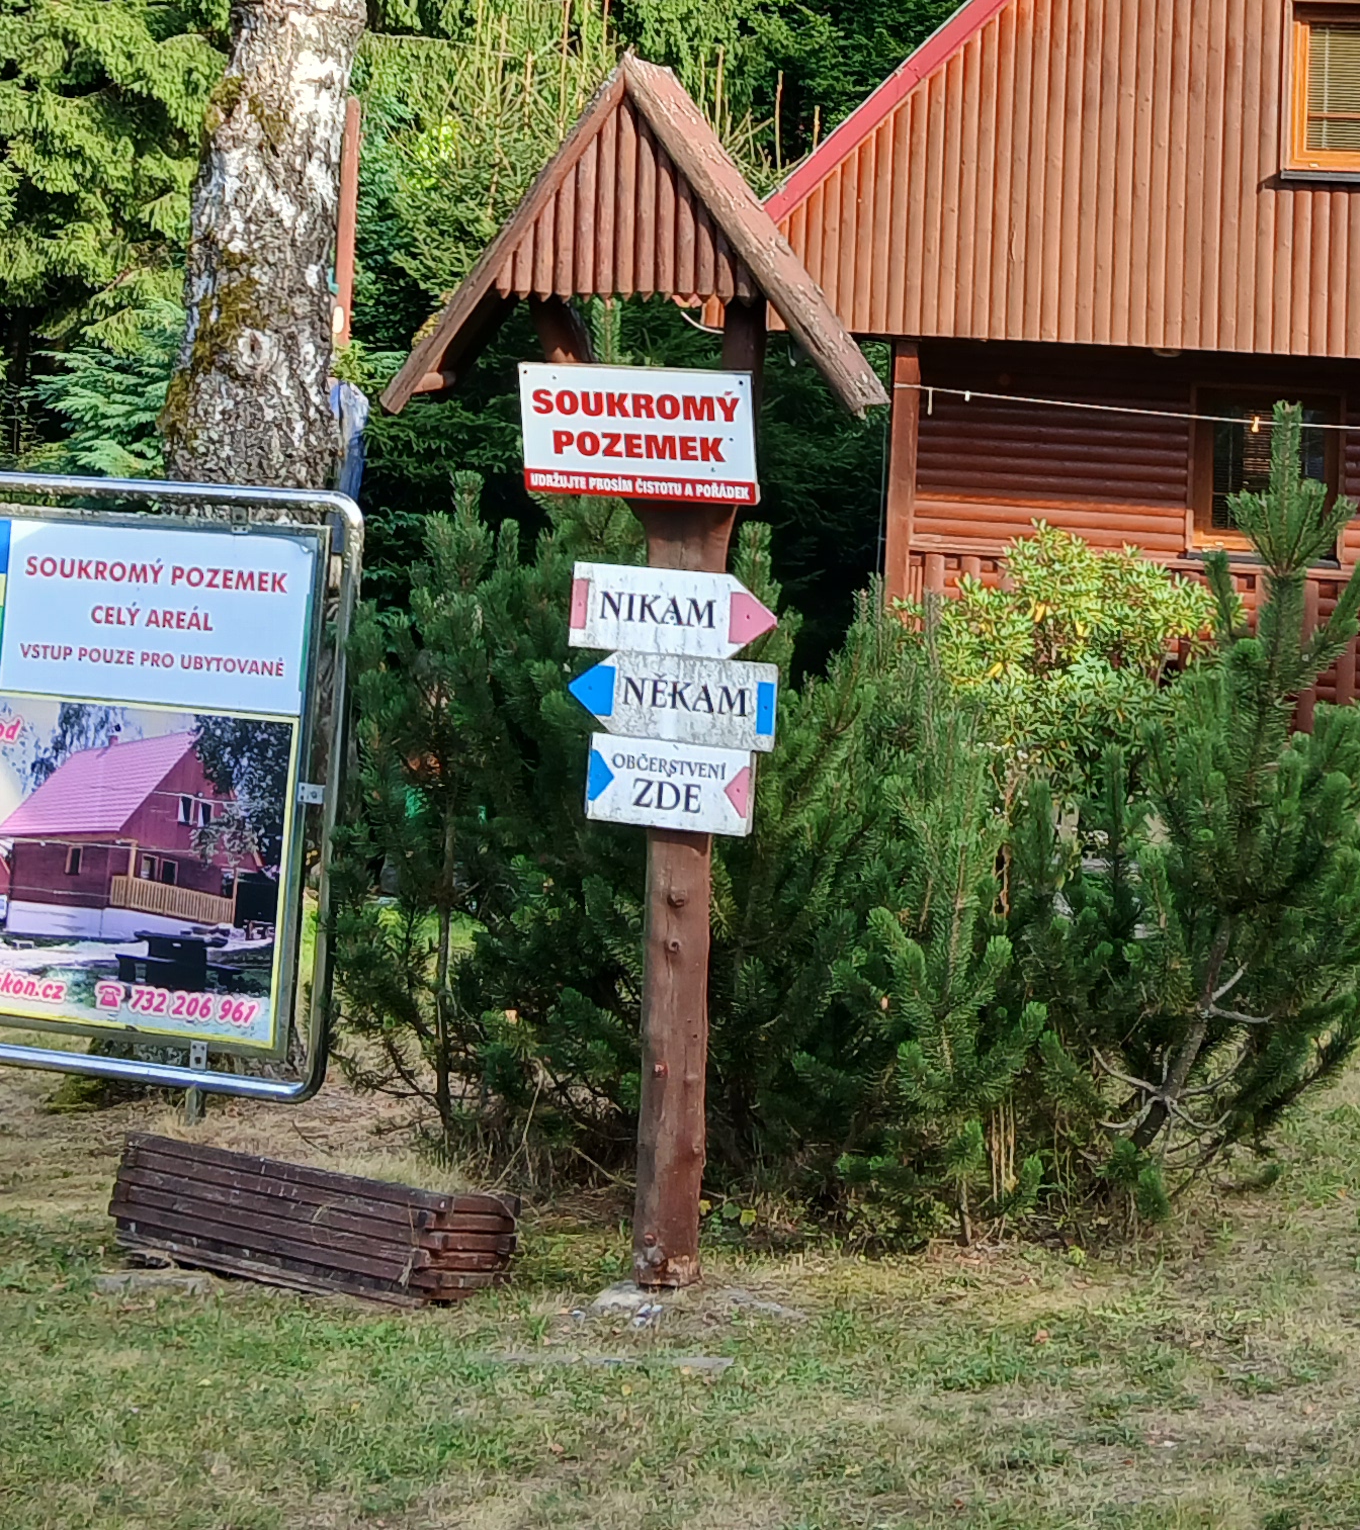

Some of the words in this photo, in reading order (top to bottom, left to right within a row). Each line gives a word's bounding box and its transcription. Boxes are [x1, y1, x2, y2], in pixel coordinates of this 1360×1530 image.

[531, 388, 740, 423] SOUKROMÝ
[552, 429, 726, 463] POZEMEK
[530, 471, 587, 490] UDRŽUJTE
[588, 476, 633, 492] PROSÍM
[635, 477, 682, 496] ČISTOTU
[684, 483, 693, 496] A
[696, 481, 750, 500] POŘÁDEK
[24, 555, 165, 585] SOUKROMÝ
[170, 565, 288, 594] POZEMEK
[90, 601, 140, 626] CELÝ
[145, 605, 213, 631] AREÁL
[599, 590, 716, 629] NIKAM
[20, 643, 73, 661] VSTUP
[78, 647, 134, 666] POUZE
[140, 651, 174, 668] PRO
[180, 654, 284, 677] UBYTOVANÉ
[621, 672, 749, 717] NĚKAM
[611, 752, 727, 781] OBČERSTVENÍ
[632, 778, 701, 814] ZDE
[130, 989, 167, 1013] 732
[171, 994, 213, 1018] 206
[220, 1000, 260, 1024] 961
